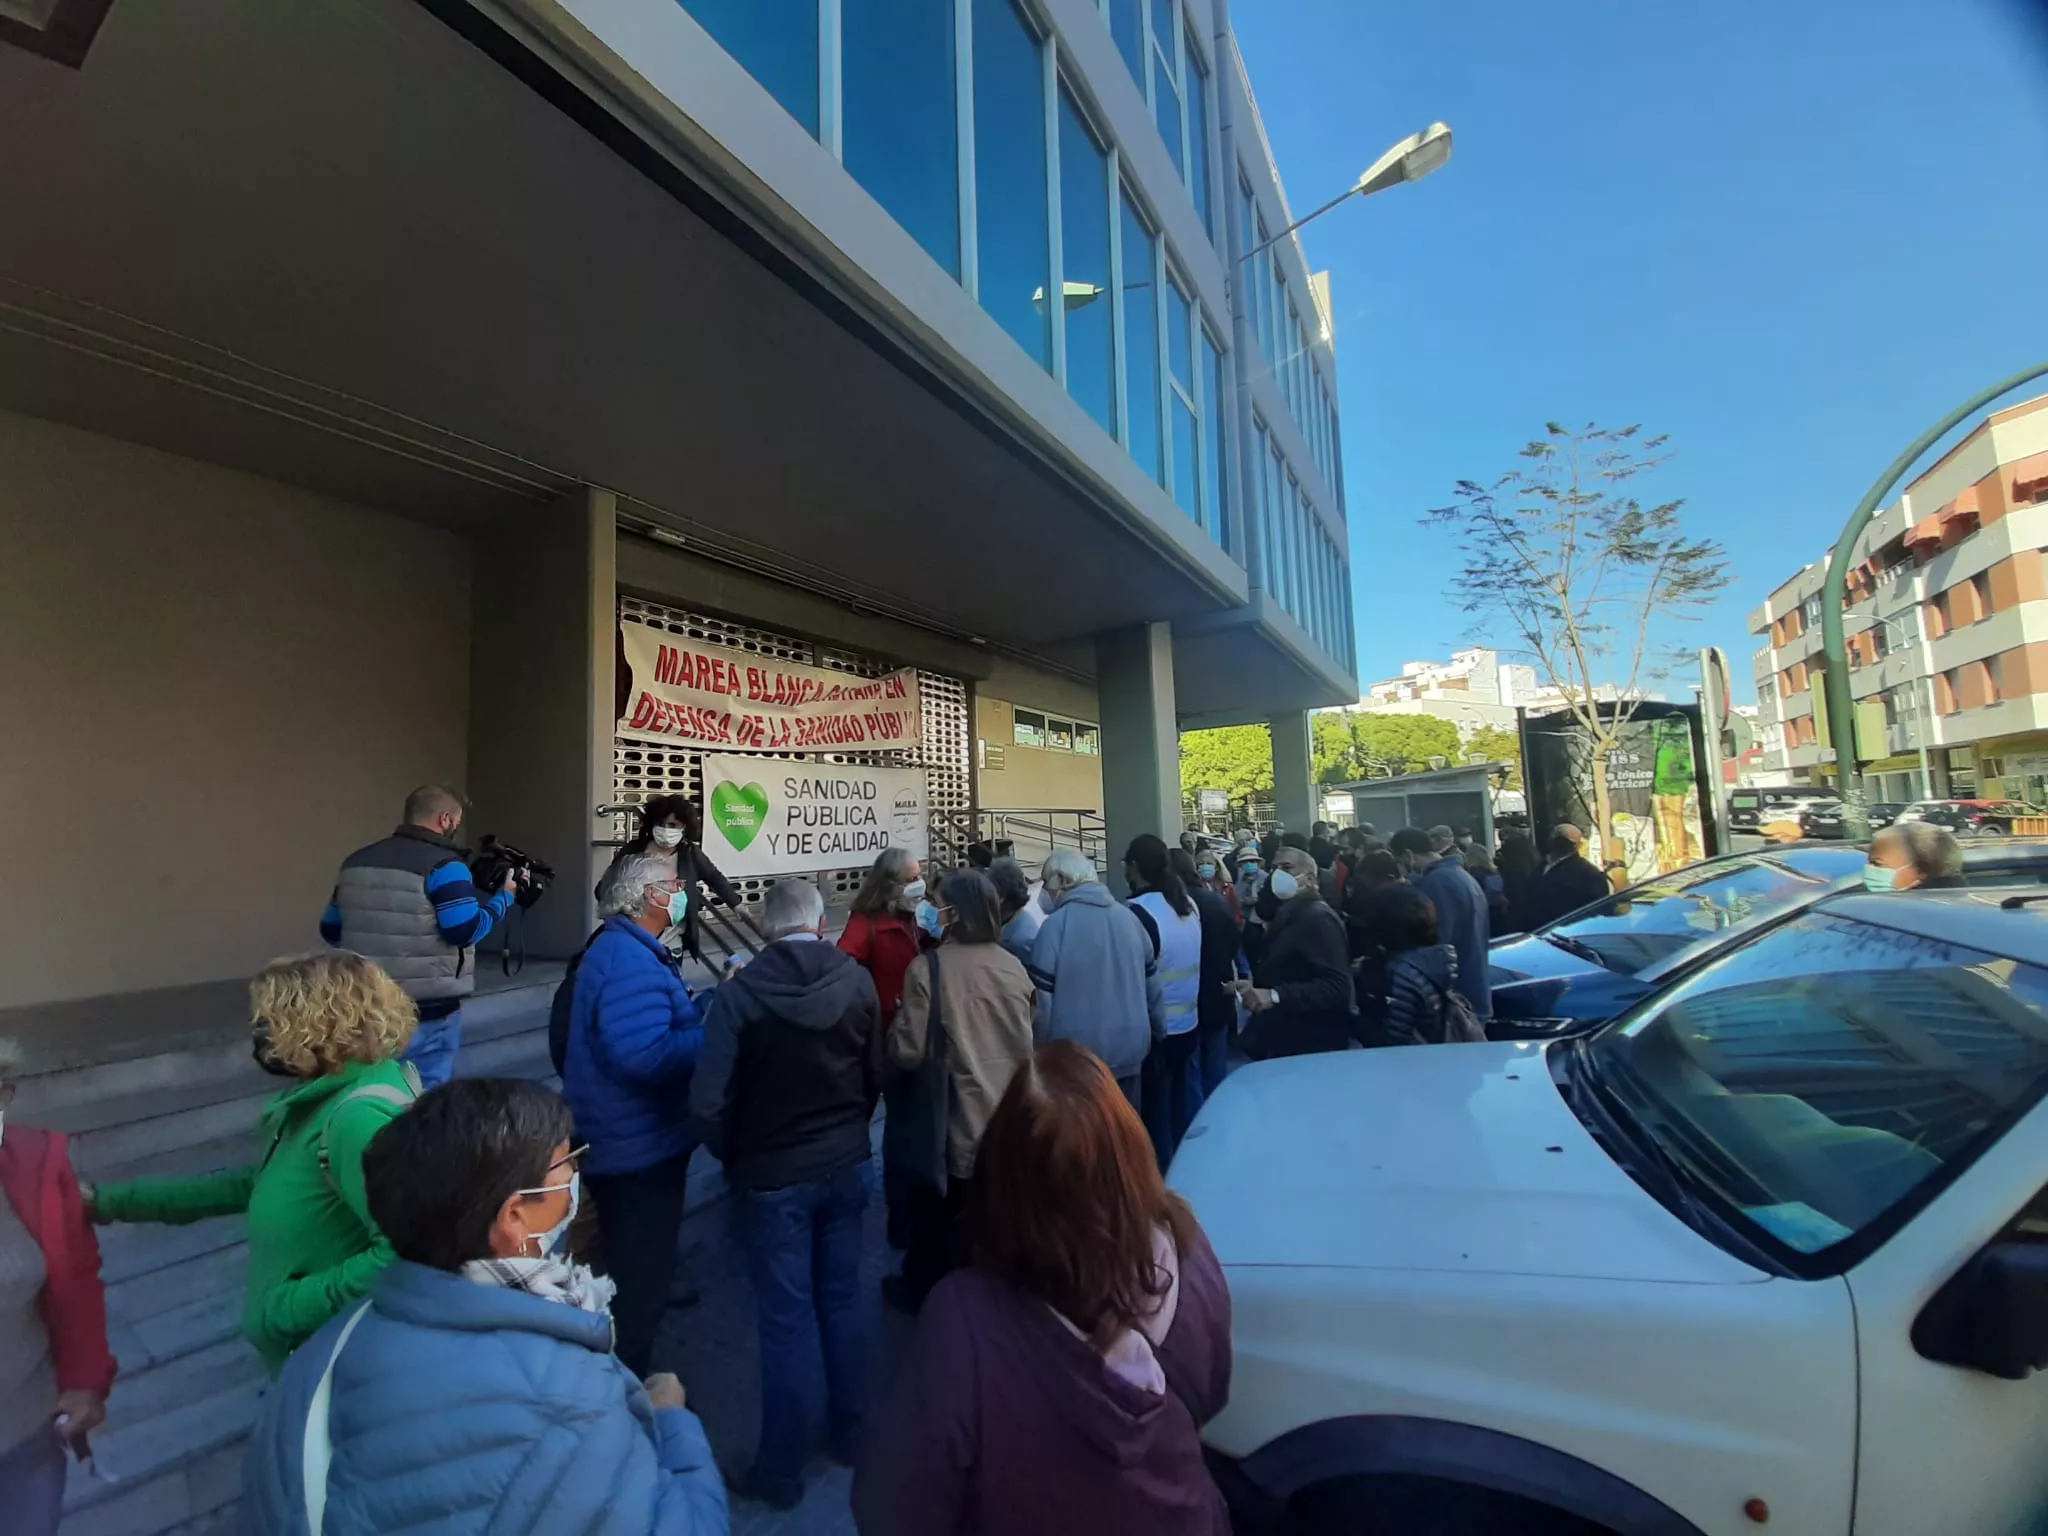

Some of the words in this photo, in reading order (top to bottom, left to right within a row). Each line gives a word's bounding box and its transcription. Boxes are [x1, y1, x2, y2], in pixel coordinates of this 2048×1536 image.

[654, 644, 741, 697] MAREA
[746, 667, 825, 706] BLANCA
[884, 675, 907, 699] EN
[629, 691, 731, 745] DEFENSA
[737, 714, 765, 747] DE
[769, 716, 791, 747] LA
[795, 714, 865, 746] SANIDAD
[784, 777, 877, 800] SANIDAD
[786, 804, 878, 827] PÚBLICA
[766, 833, 780, 855] Y
[787, 833, 813, 854] DE
[818, 831, 889, 854] CALIDAD
